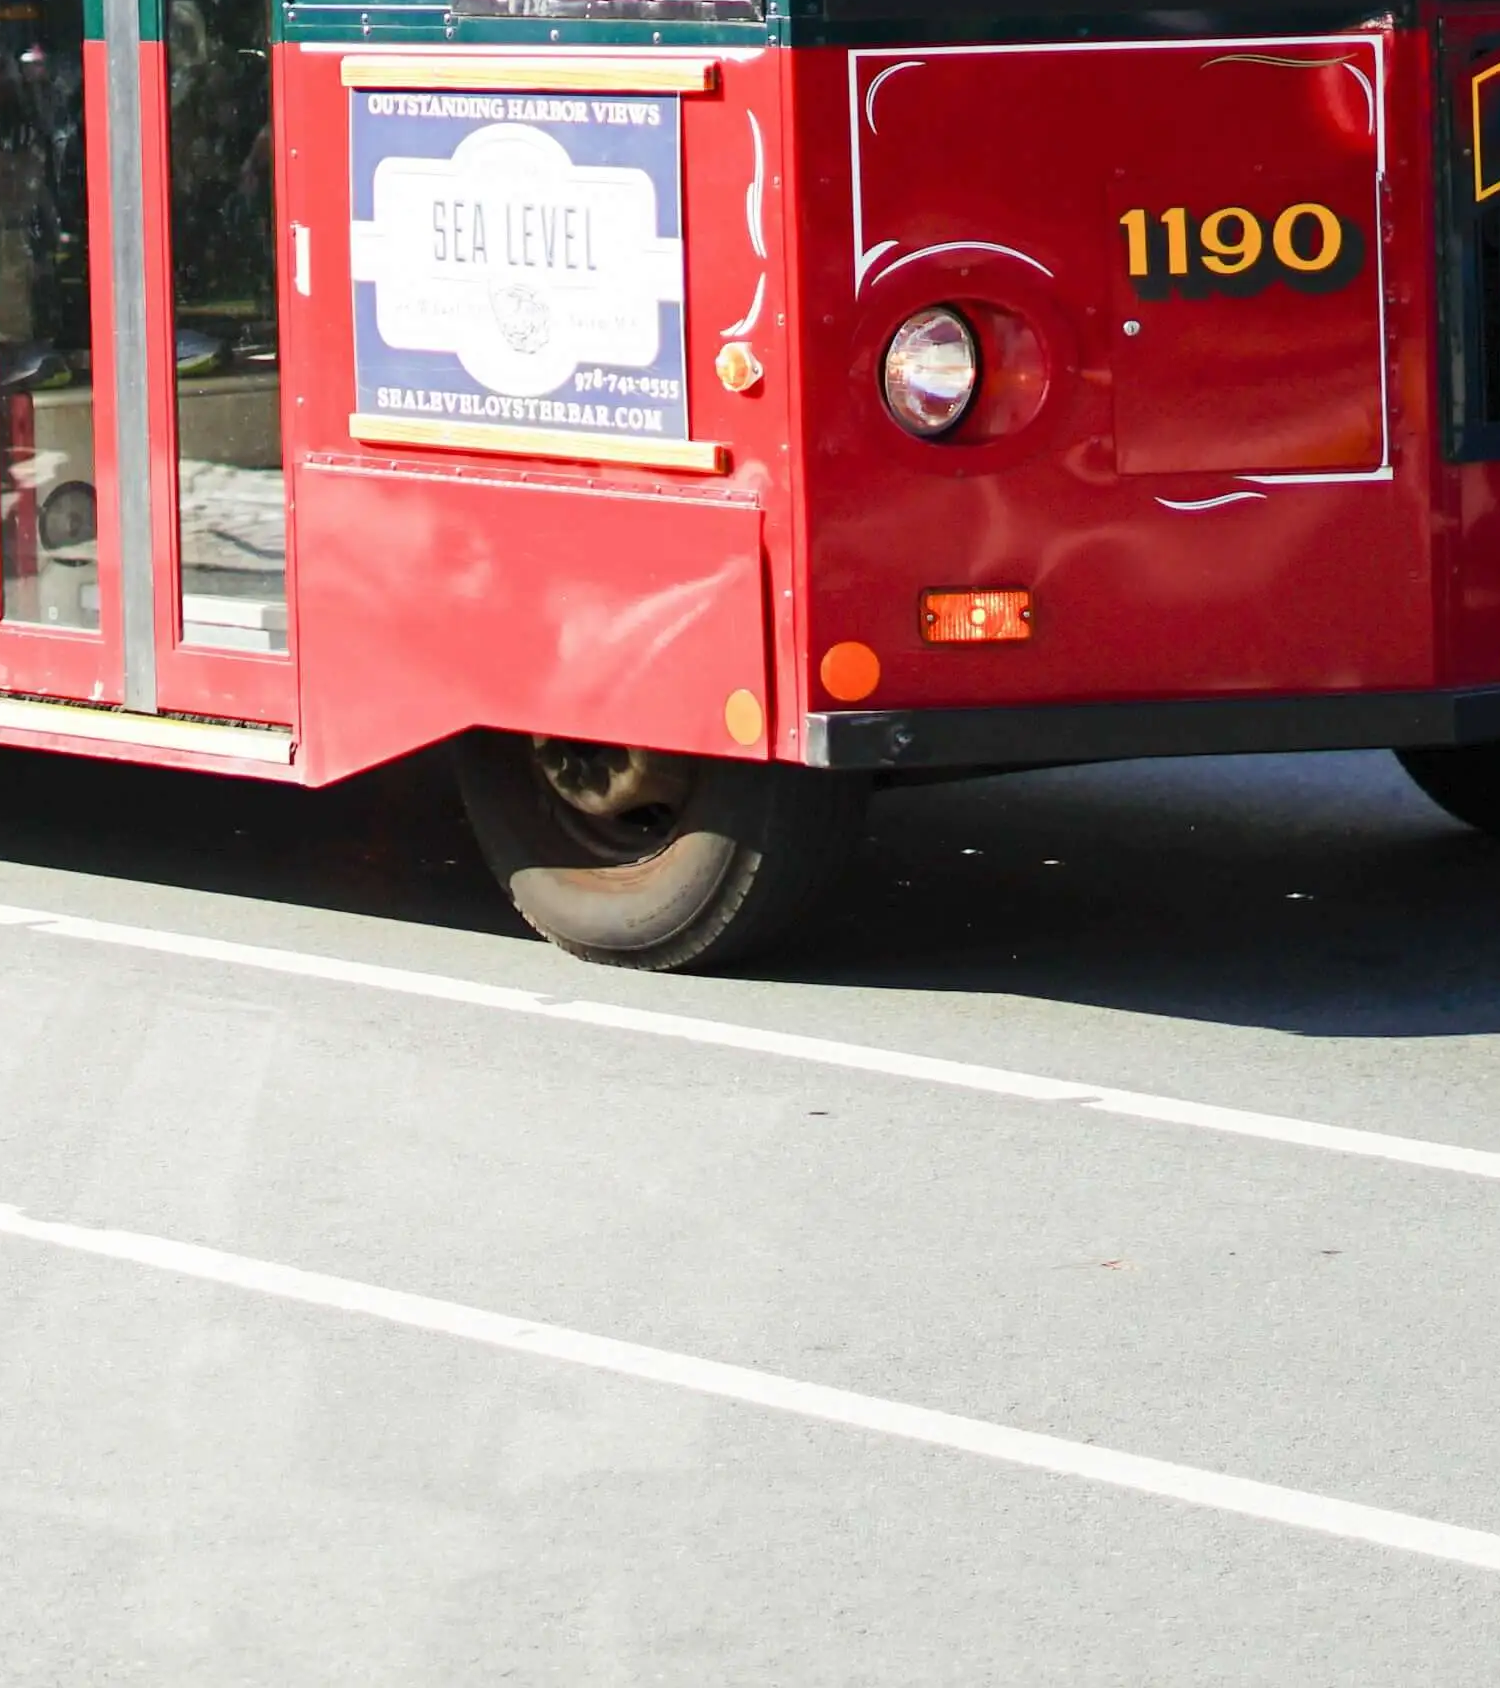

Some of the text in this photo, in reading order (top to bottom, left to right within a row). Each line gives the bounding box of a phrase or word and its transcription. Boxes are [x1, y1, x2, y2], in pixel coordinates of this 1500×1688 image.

[367, 94, 661, 126] OUTSTANDING HARBOR VIEWS
[433, 200, 598, 271] SEA LEVEL
[1120, 203, 1344, 276] 1190
[376, 387, 663, 432] SEALEVELOYSTERBAR.COM
